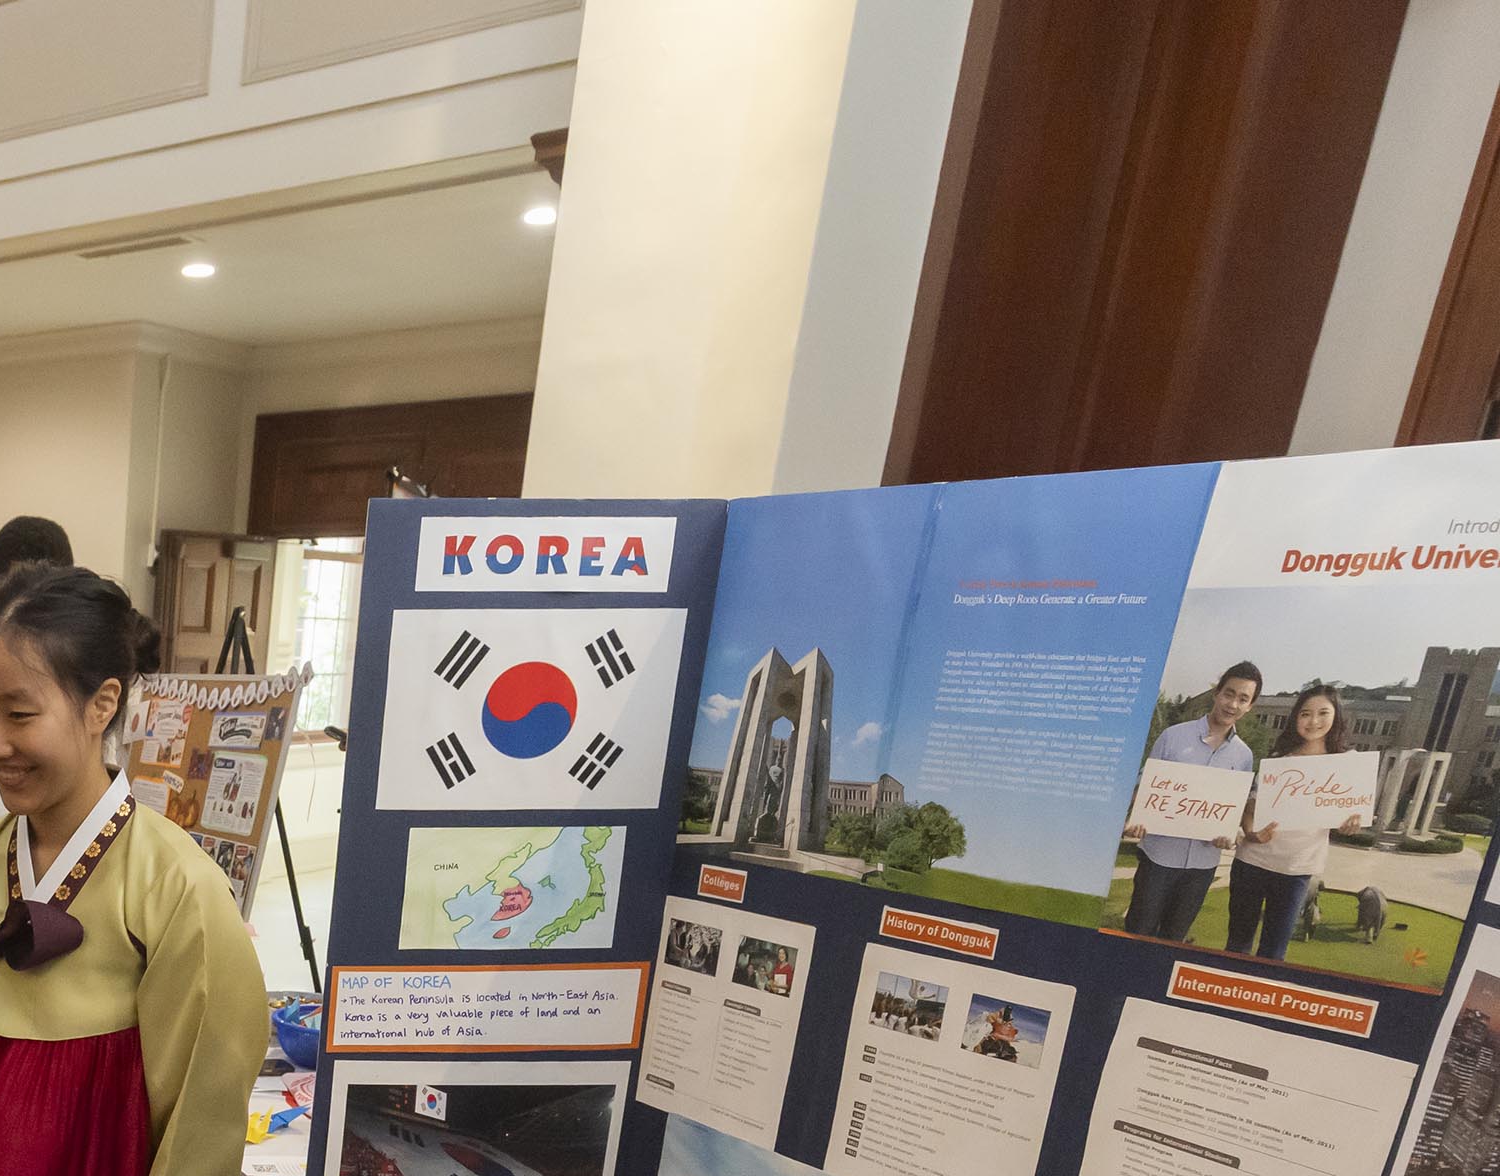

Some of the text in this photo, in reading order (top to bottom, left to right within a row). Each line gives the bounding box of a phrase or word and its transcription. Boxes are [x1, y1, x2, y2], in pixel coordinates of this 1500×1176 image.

[441, 534, 649, 576] KOREA
[1281, 544, 1500, 577] Dongguk Unive
[954, 594, 992, 607] Dongguk's
[994, 595, 1016, 607] Deep
[1017, 595, 1038, 604] Roots
[1040, 594, 1076, 604] Generate
[1085, 594, 1116, 604] Greater
[1117, 594, 1147, 604] Future
[1151, 776, 1188, 792] Let us
[1262, 769, 1352, 808] My Pride
[1144, 794, 1236, 822] RE_START
[1314, 793, 1372, 808] Dongguk!
[433, 862, 459, 871] CHINA
[703, 874, 740, 892] Colleges
[886, 914, 992, 949] History of Dongguk
[342, 975, 451, 989] MAP OF KOREA
[350, 990, 619, 1006] The Korean Peninsula is located in North-East Asia.
[1177, 976, 1365, 1023] International Programs
[345, 1012, 373, 1022] Korea
[377, 1012, 387, 1022] is
[406, 1011, 429, 1024] very
[436, 1008, 483, 1019] valuable
[490, 1008, 514, 1019] piece
[520, 1007, 530, 1019] of
[536, 1007, 557, 1018] land
[562, 1007, 580, 1016] and
[340, 1025, 488, 1039] international hub of Asia.
[1172, 1048, 1232, 1069] International Facts
[1123, 1125, 1232, 1164] Programs for International Students
